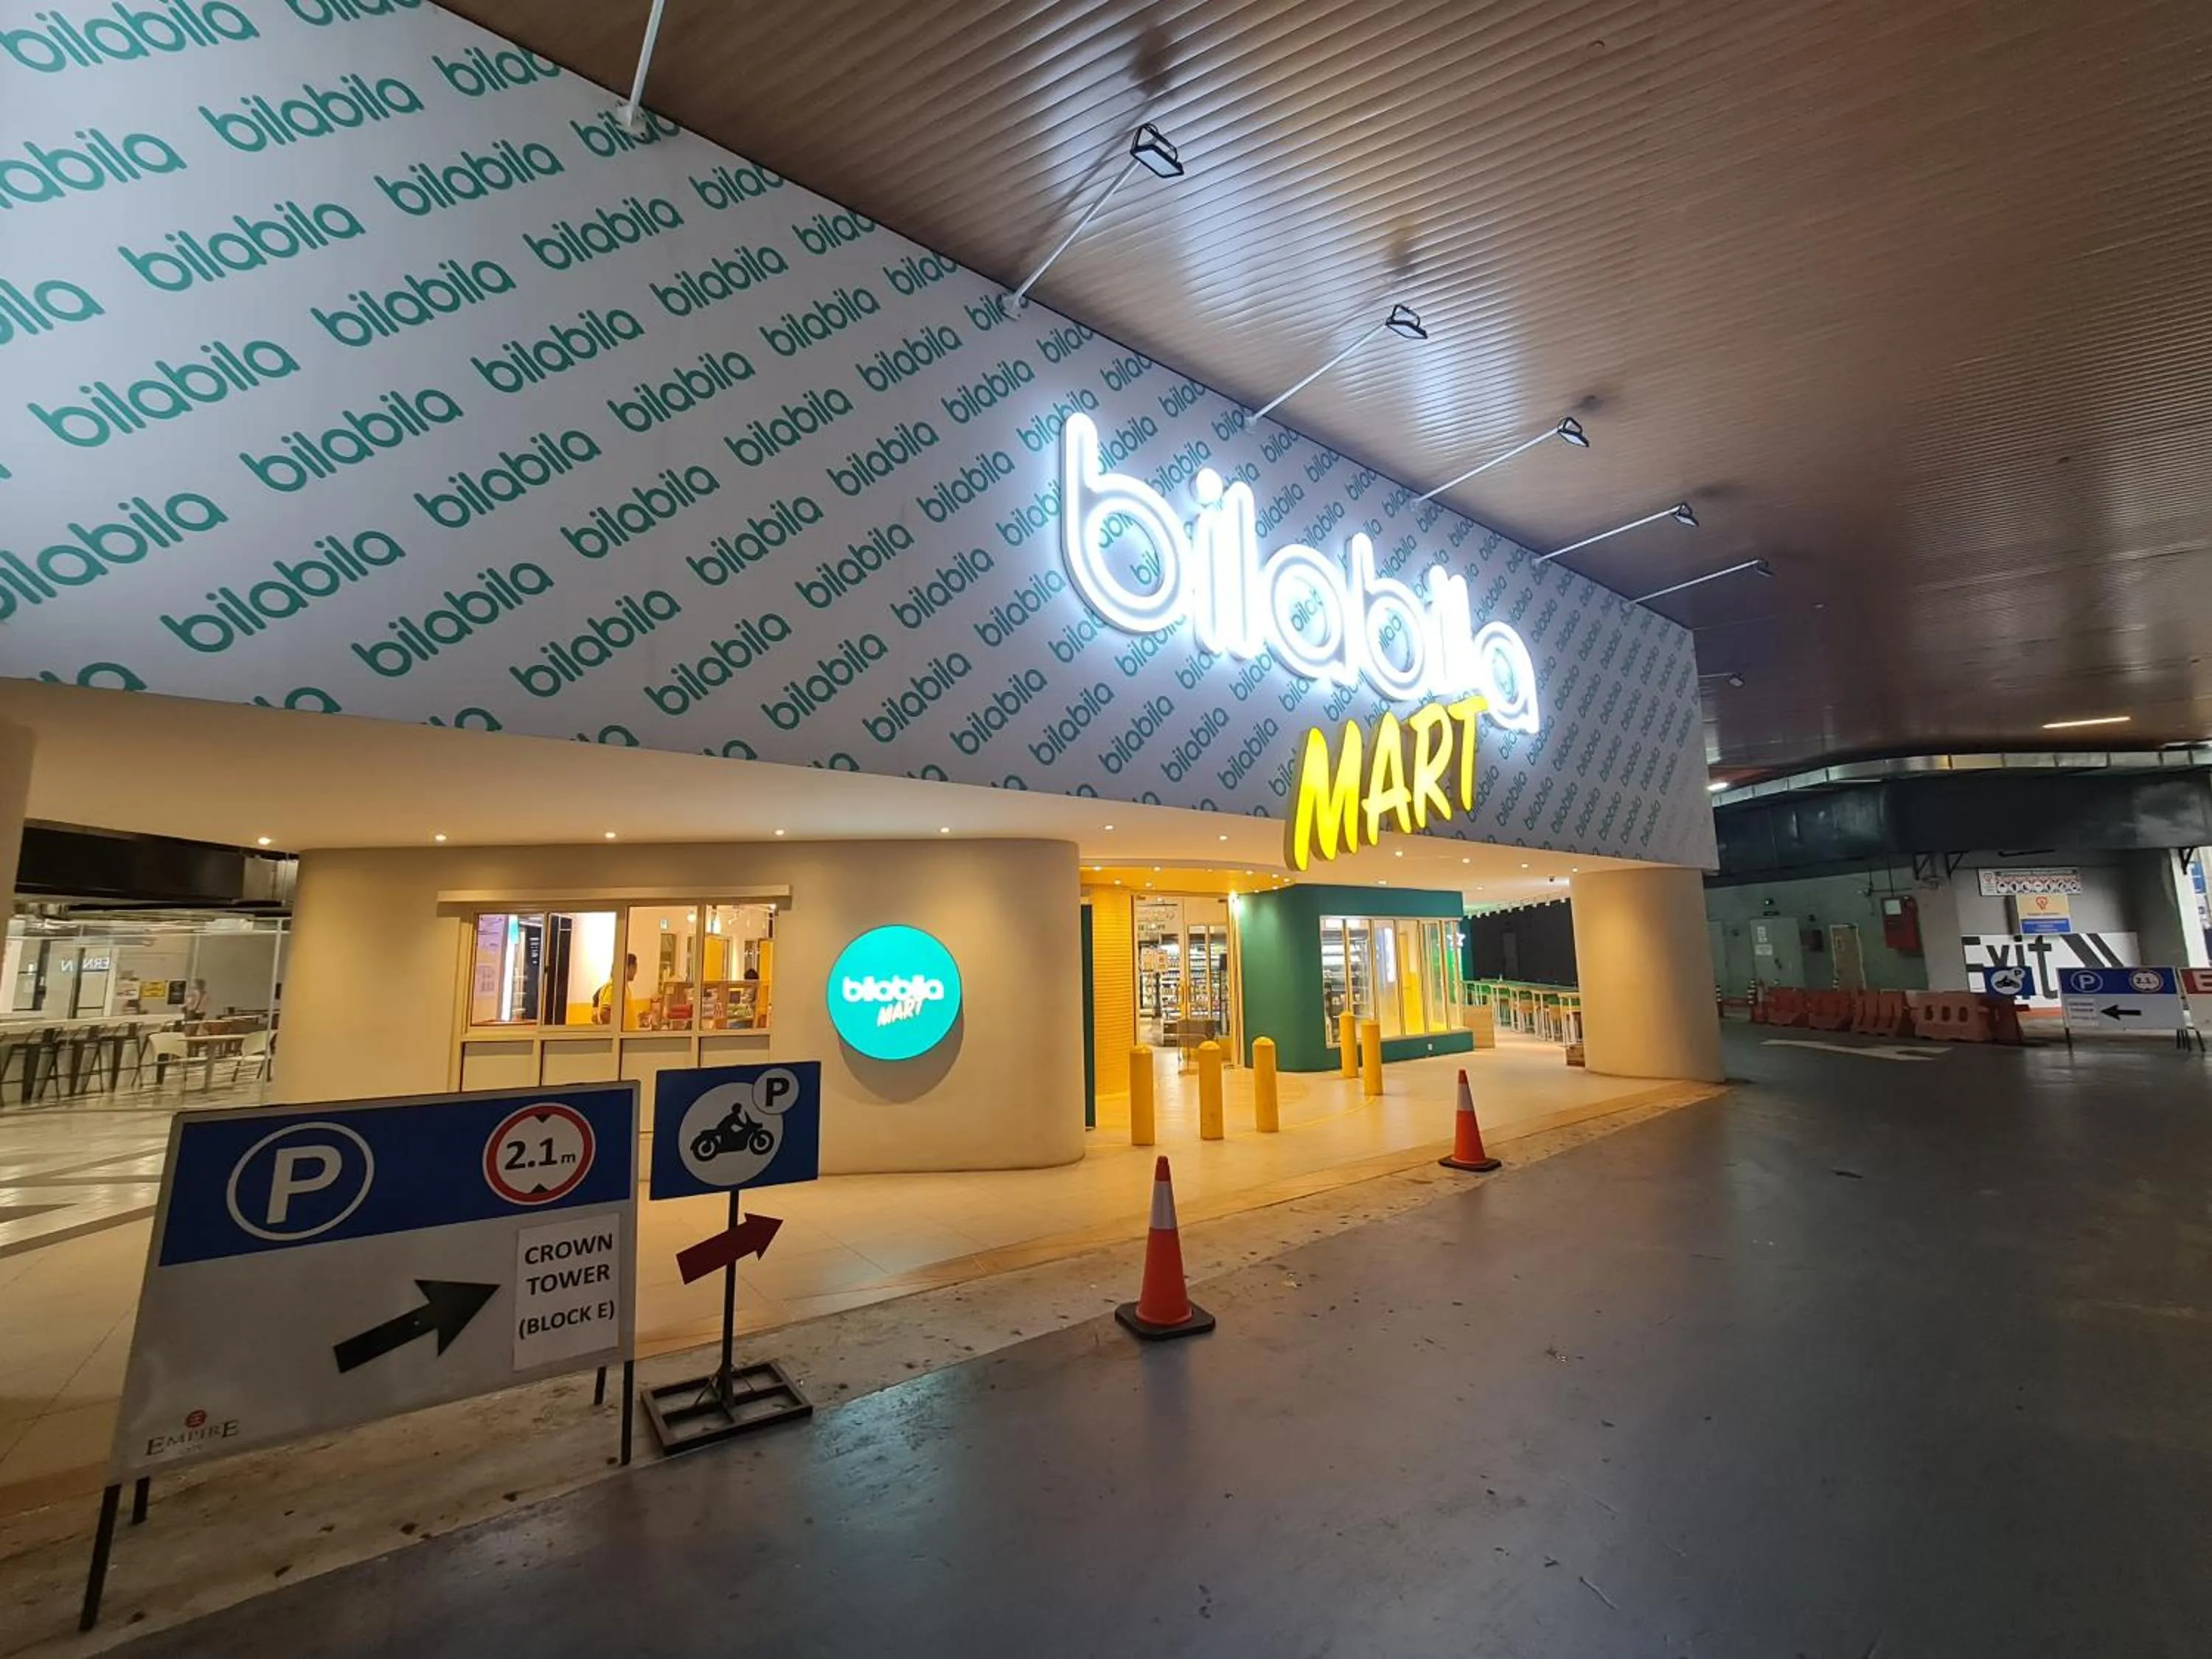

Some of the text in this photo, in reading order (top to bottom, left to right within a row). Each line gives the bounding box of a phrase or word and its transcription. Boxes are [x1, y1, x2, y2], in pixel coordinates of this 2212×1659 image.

[0, 0, 260, 74] bilabila
[199, 74, 424, 150] bilabila
[375, 139, 563, 214] bilabila
[119, 201, 364, 290] bilabila
[523, 197, 684, 268] bilabila
[0, 280, 105, 345] ila
[310, 260, 515, 345] bilabila
[650, 246, 788, 316] bilabila
[470, 310, 644, 392] bilabila
[759, 289, 880, 356] bilabila
[855, 327, 961, 392] bilabila
[29, 340, 299, 446] bilabila
[607, 352, 755, 431] bilabila
[724, 389, 852, 466] bilabila
[941, 360, 1034, 423] bilabila
[239, 389, 462, 490] bilabila
[414, 431, 600, 526] bilabila
[827, 422, 939, 495] bilabila
[560, 467, 720, 558] bilabila
[917, 451, 1015, 522] bilabila
[0, 493, 226, 620] ilabila
[686, 498, 823, 585] bilabila
[795, 525, 914, 608] bilabila
[1061, 411, 1540, 734] bilabila
[160, 531, 404, 651] bilabila
[350, 563, 553, 675] bilabila
[890, 549, 994, 628] bilabila
[973, 570, 1065, 646] bilabila
[509, 591, 681, 696] bilabila
[644, 614, 791, 714] bilabila
[761, 635, 887, 729] bilabila
[862, 653, 972, 742] bilabila
[950, 669, 1047, 754] bilabila
[1029, 684, 1113, 764] bilabila
[1098, 696, 1174, 773] bilabila
[1161, 708, 1228, 782] bilabila
[1217, 718, 1278, 789] bilabila
[1287, 694, 1487, 871] MART
[842, 974, 944, 1002] bilabila
[877, 996, 925, 1027] MART
[2079, 975, 2096, 990] P
[765, 1078, 790, 1106] P
[266, 1144, 342, 1225] P
[524, 1232, 613, 1265] CROWN
[526, 1264, 610, 1295] TOWER
[519, 1300, 614, 1340] (BLOCK E)
